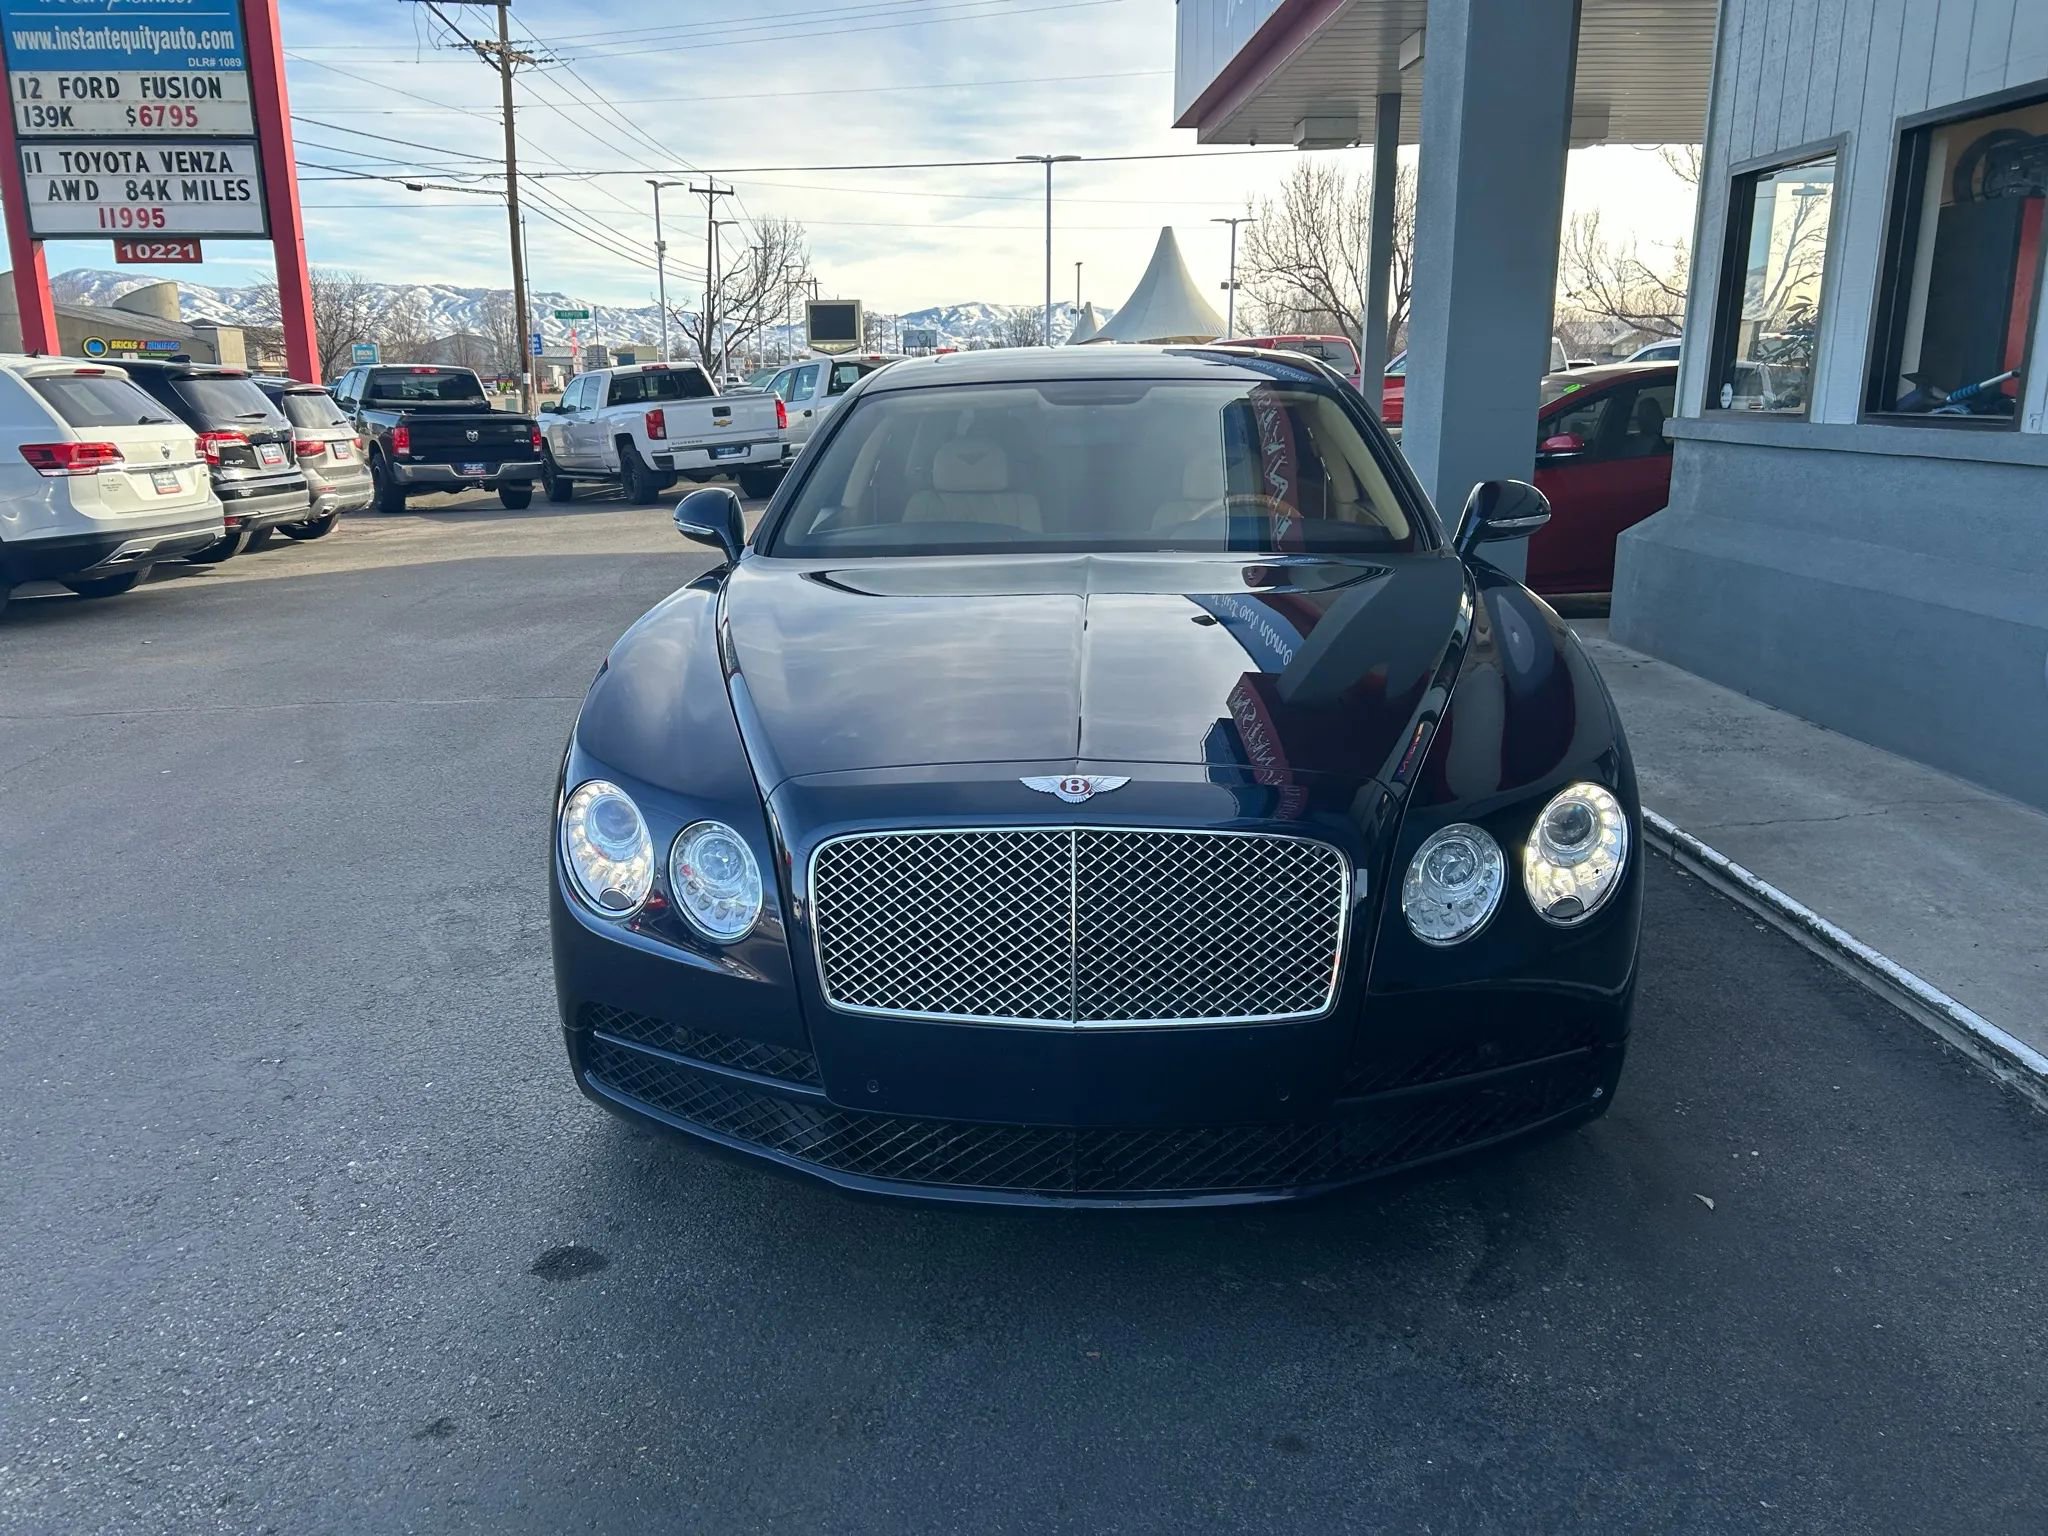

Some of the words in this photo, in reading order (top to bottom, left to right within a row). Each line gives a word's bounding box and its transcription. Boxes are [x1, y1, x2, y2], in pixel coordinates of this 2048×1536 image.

[12, 25, 235, 54] www.instantequityauto.com
[188, 57, 216, 67] DLR#
[218, 57, 242, 67] 1089
[19, 77, 42, 99] 12
[58, 77, 120, 99] FORD
[140, 76, 222, 98] FUSION
[23, 106, 74, 127] 139K
[126, 105, 198, 127] $6795
[24, 152, 42, 173] 11
[59, 151, 150, 173] TOYOTA
[159, 151, 233, 173] VENZA
[48, 180, 99, 201] AWD
[125, 180, 172, 201] 84K
[182, 179, 250, 201] MILES
[99, 207, 166, 228] 11995
[121, 244, 195, 259] 10221
[111, 340, 138, 350] BRICKS
